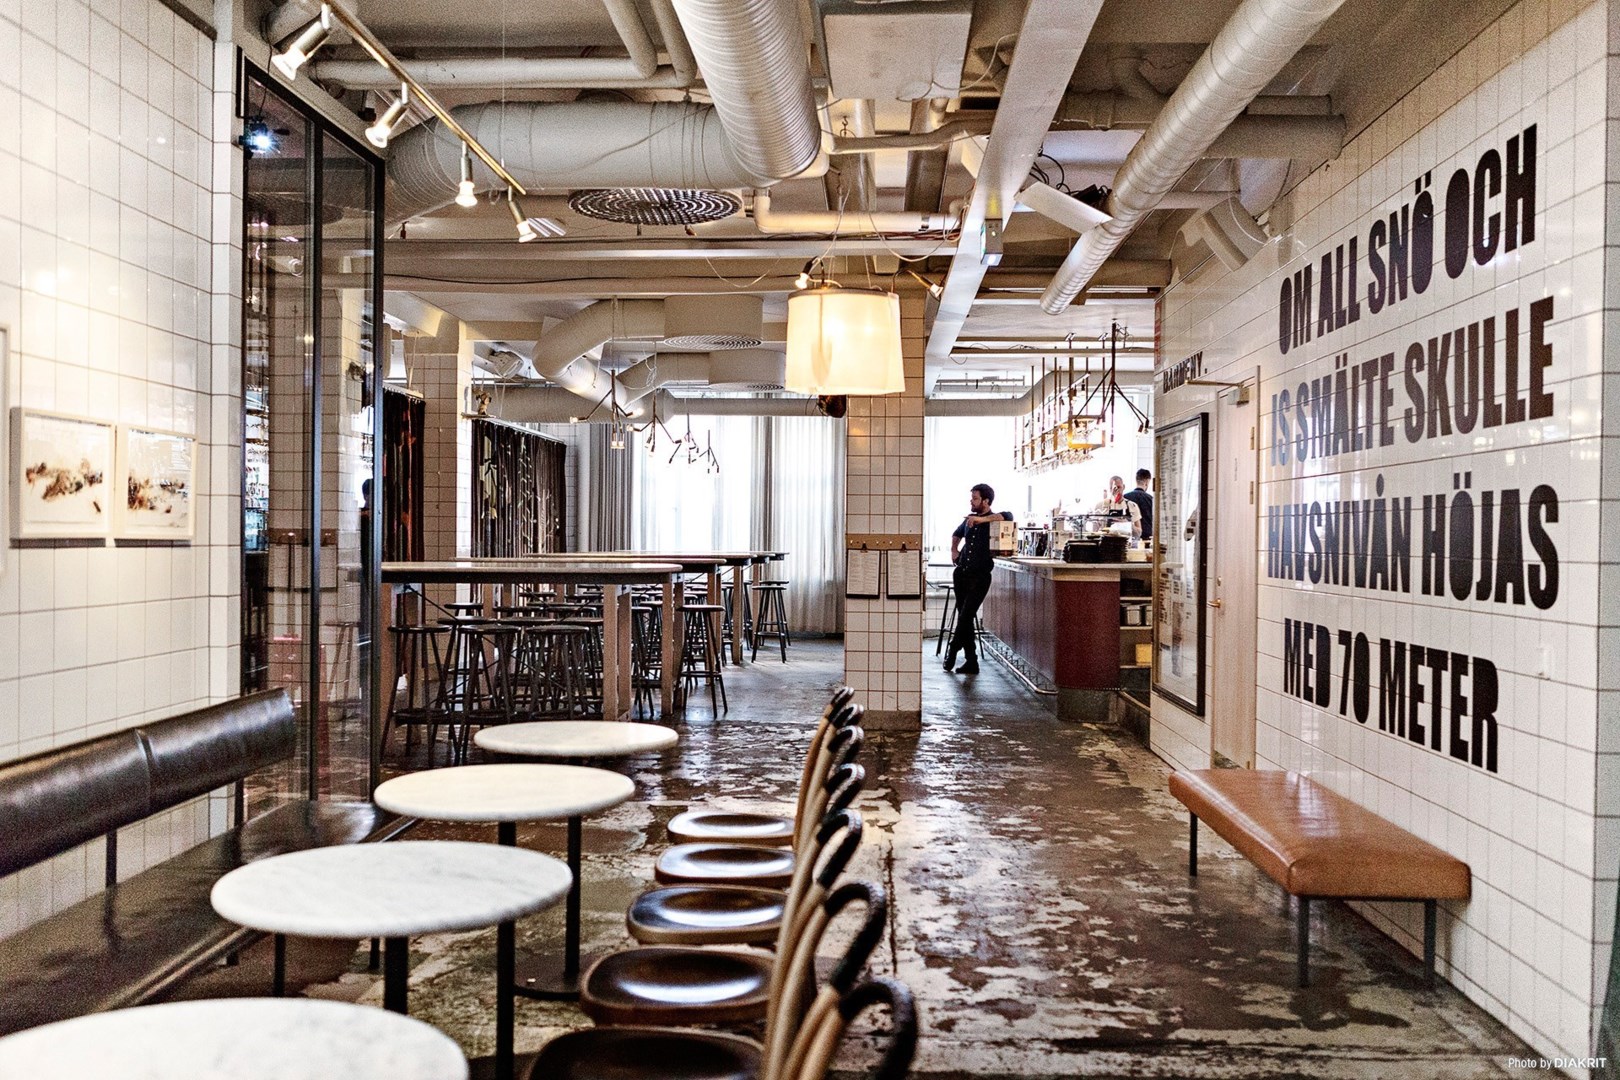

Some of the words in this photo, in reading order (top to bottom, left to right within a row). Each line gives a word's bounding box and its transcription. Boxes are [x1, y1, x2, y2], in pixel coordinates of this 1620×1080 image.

[1279, 263, 1313, 355] OM
[1317, 235, 1360, 338] ALL
[1368, 170, 1434, 315] SNÖ
[1445, 123, 1537, 280] OCH
[1271, 388, 1290, 466] IS
[1295, 352, 1394, 463] SMÄLTE
[1404, 295, 1554, 443] SKULLE
[1268, 473, 1412, 593] HAVSNIVÅN
[1421, 471, 1559, 610] HÖJAS
[1284, 617, 1331, 708] MED
[1338, 629, 1370, 724] 70
[1379, 638, 1498, 773] METER
